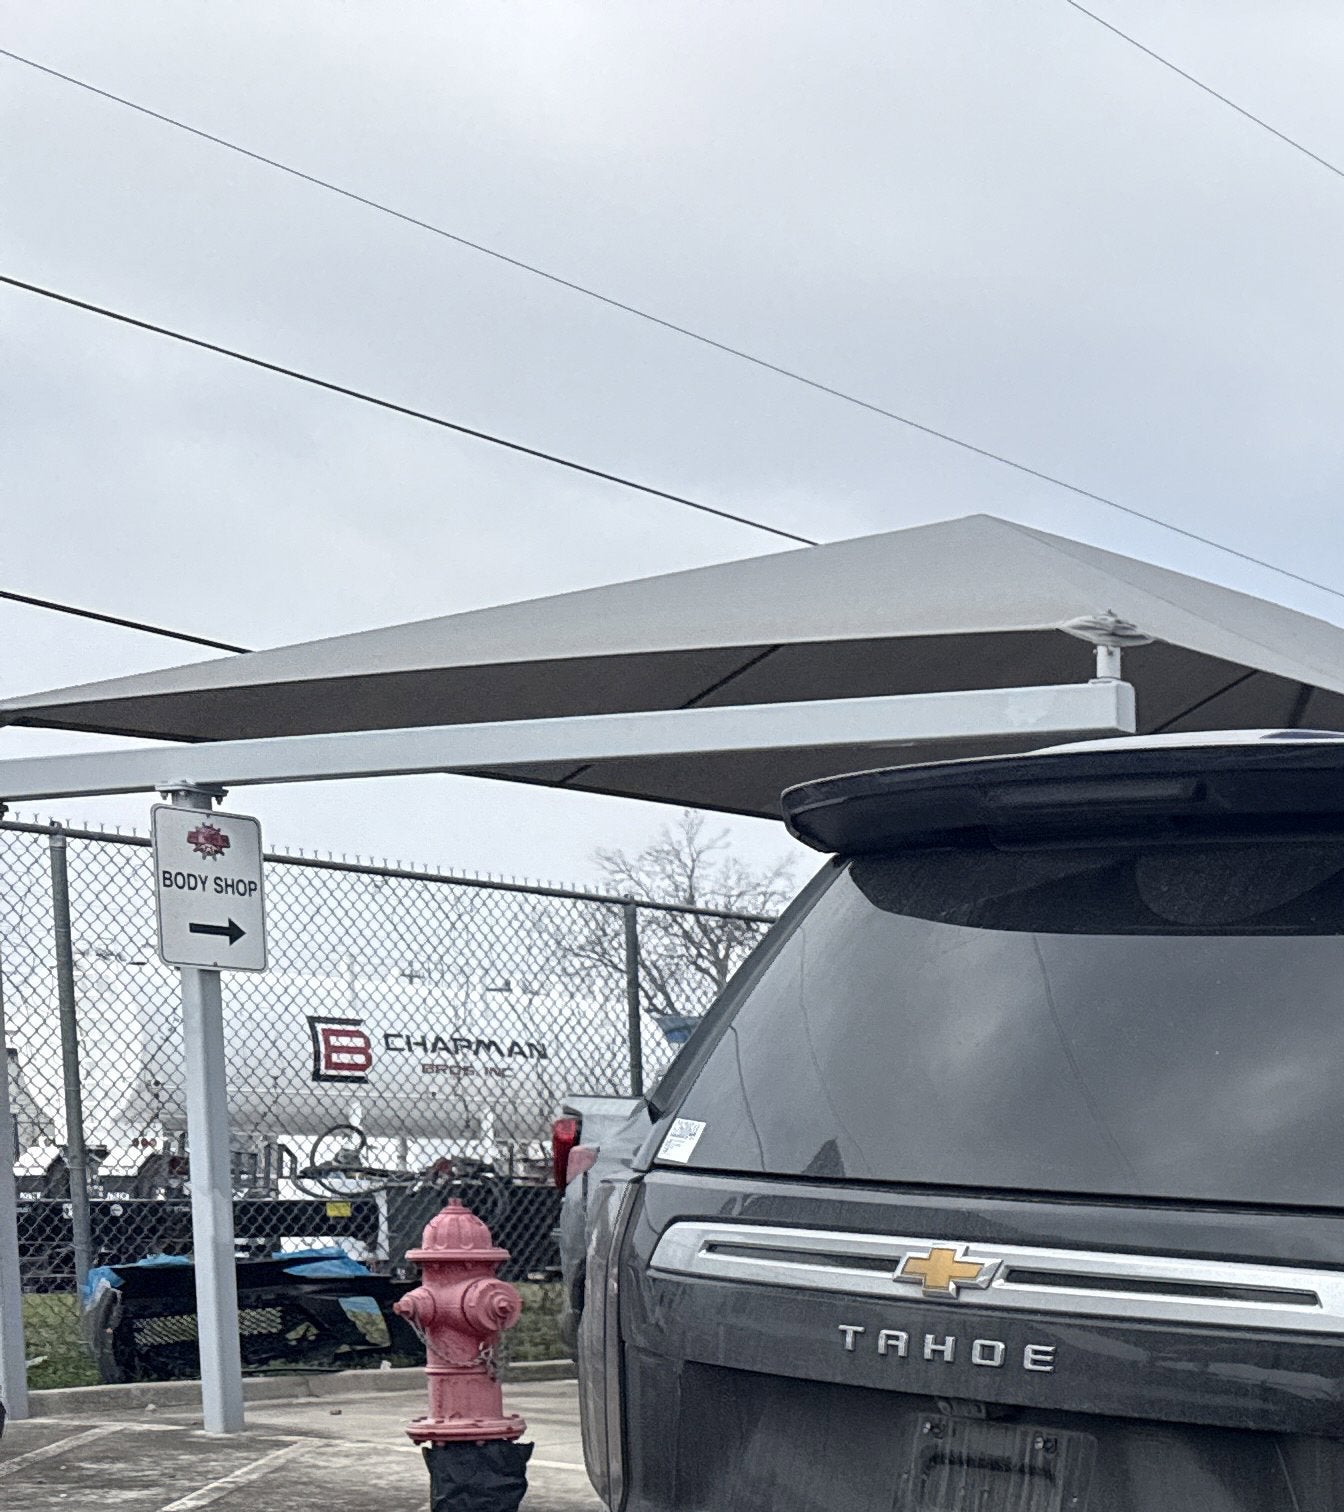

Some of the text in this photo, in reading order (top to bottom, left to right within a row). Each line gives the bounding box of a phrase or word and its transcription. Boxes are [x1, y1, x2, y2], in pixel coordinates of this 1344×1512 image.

[162, 870, 258, 897] BODY SHOP
[384, 1033, 549, 1060] CHAPMAN
[838, 1324, 1056, 1372] TAHOE
